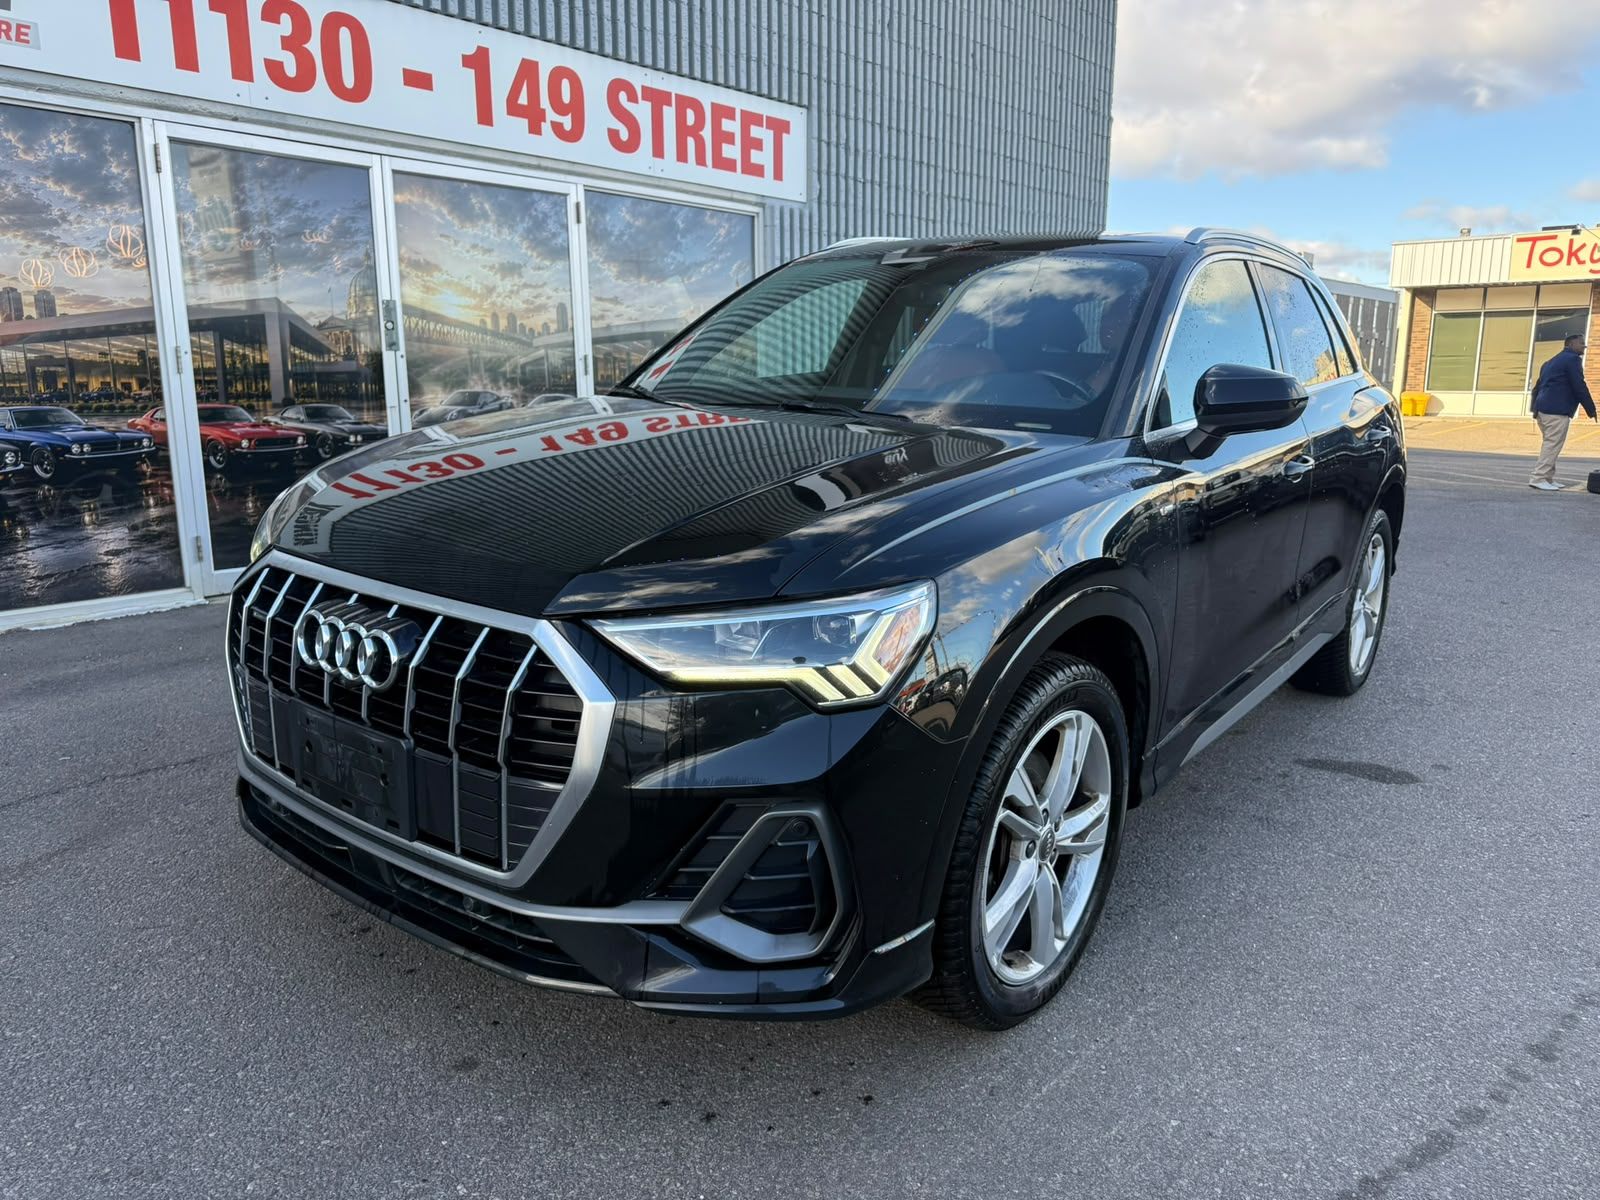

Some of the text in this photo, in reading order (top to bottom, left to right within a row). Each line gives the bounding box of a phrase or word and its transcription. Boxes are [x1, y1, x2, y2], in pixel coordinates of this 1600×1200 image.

[107, 0, 373, 103] 11130
[461, 45, 585, 144] 149
[606, 77, 791, 182] STREET
